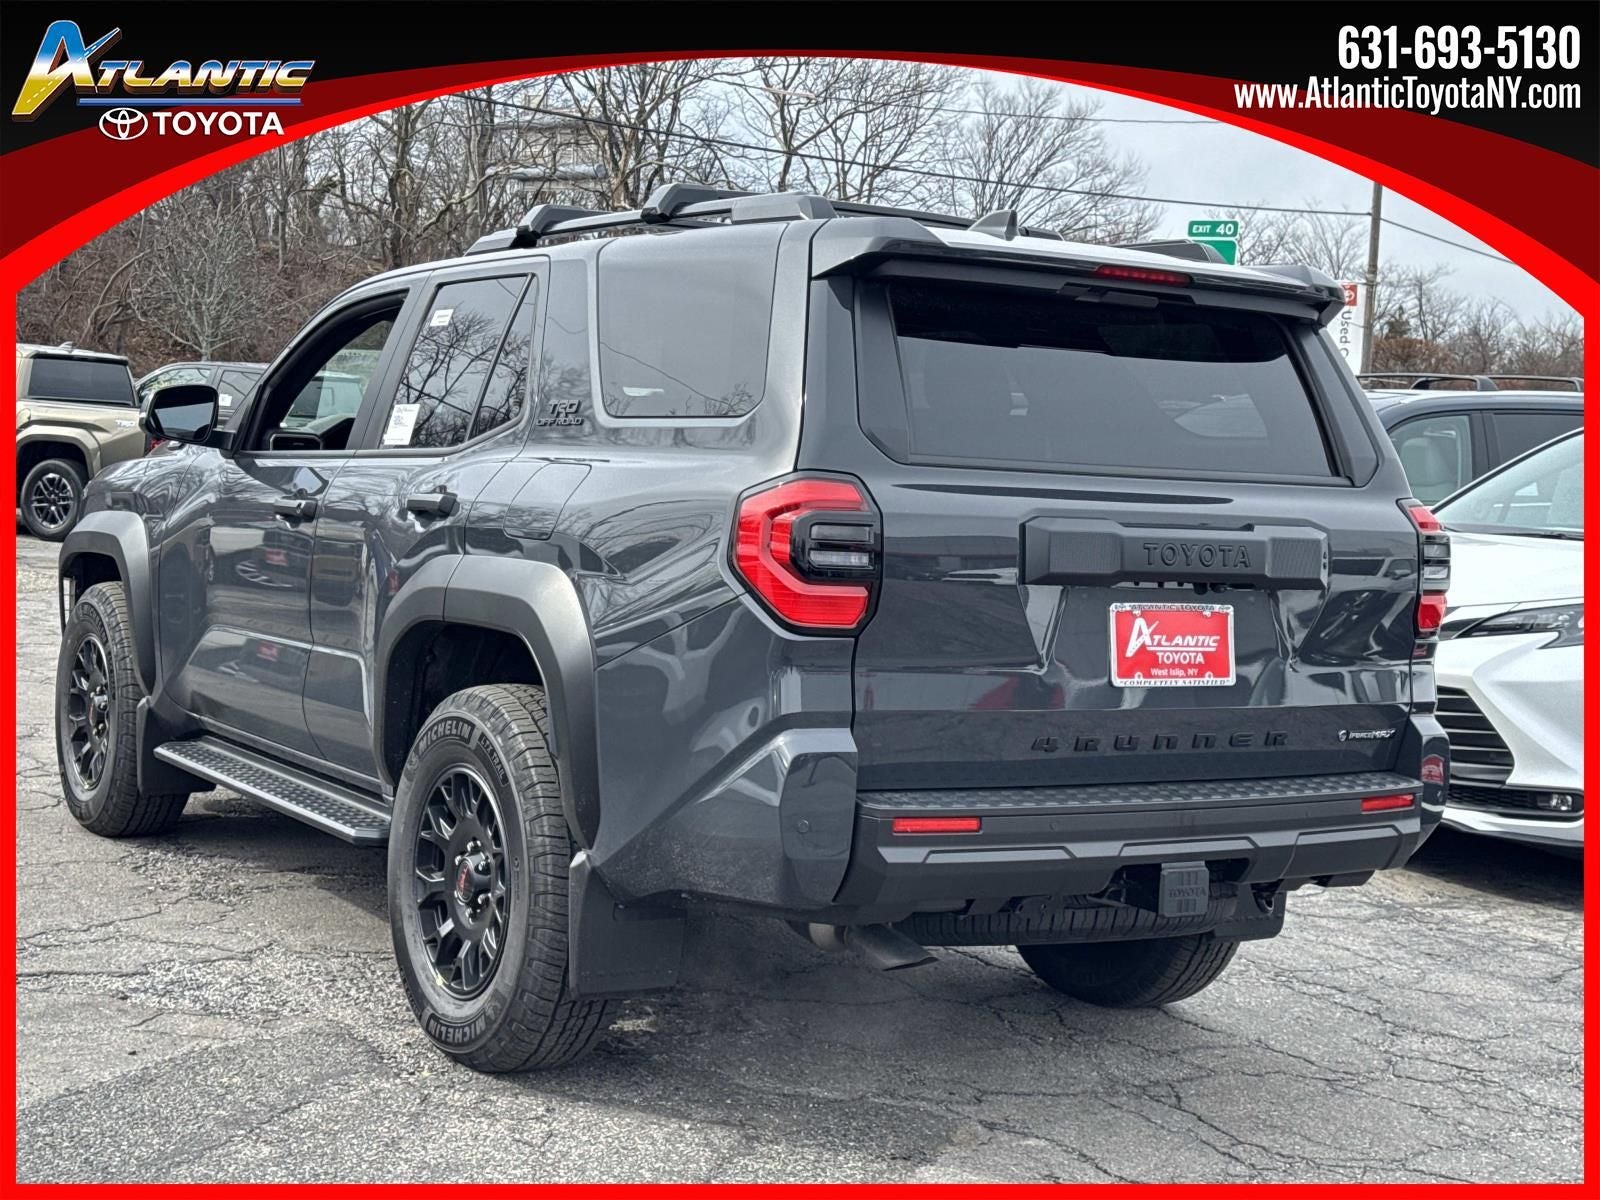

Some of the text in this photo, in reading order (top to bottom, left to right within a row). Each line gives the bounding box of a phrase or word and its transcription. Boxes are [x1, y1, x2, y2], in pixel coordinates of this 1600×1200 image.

[1192, 223, 1235, 236] EXIT 40
[1340, 311, 1353, 344] Used
[548, 399, 582, 418] TRD
[1142, 542, 1252, 568] TOYOTA
[1180, 604, 1215, 612] TOYOTA
[1125, 617, 1221, 658] ATLANTIC
[1156, 652, 1205, 665] TOYOTA
[1150, 667, 1199, 678] West Islip, NY
[418, 719, 473, 756] MICHELIN
[1030, 730, 1290, 753] 4RUNNER
[491, 751, 506, 781] TRAIL
[427, 1014, 487, 1045] MICHELIN
